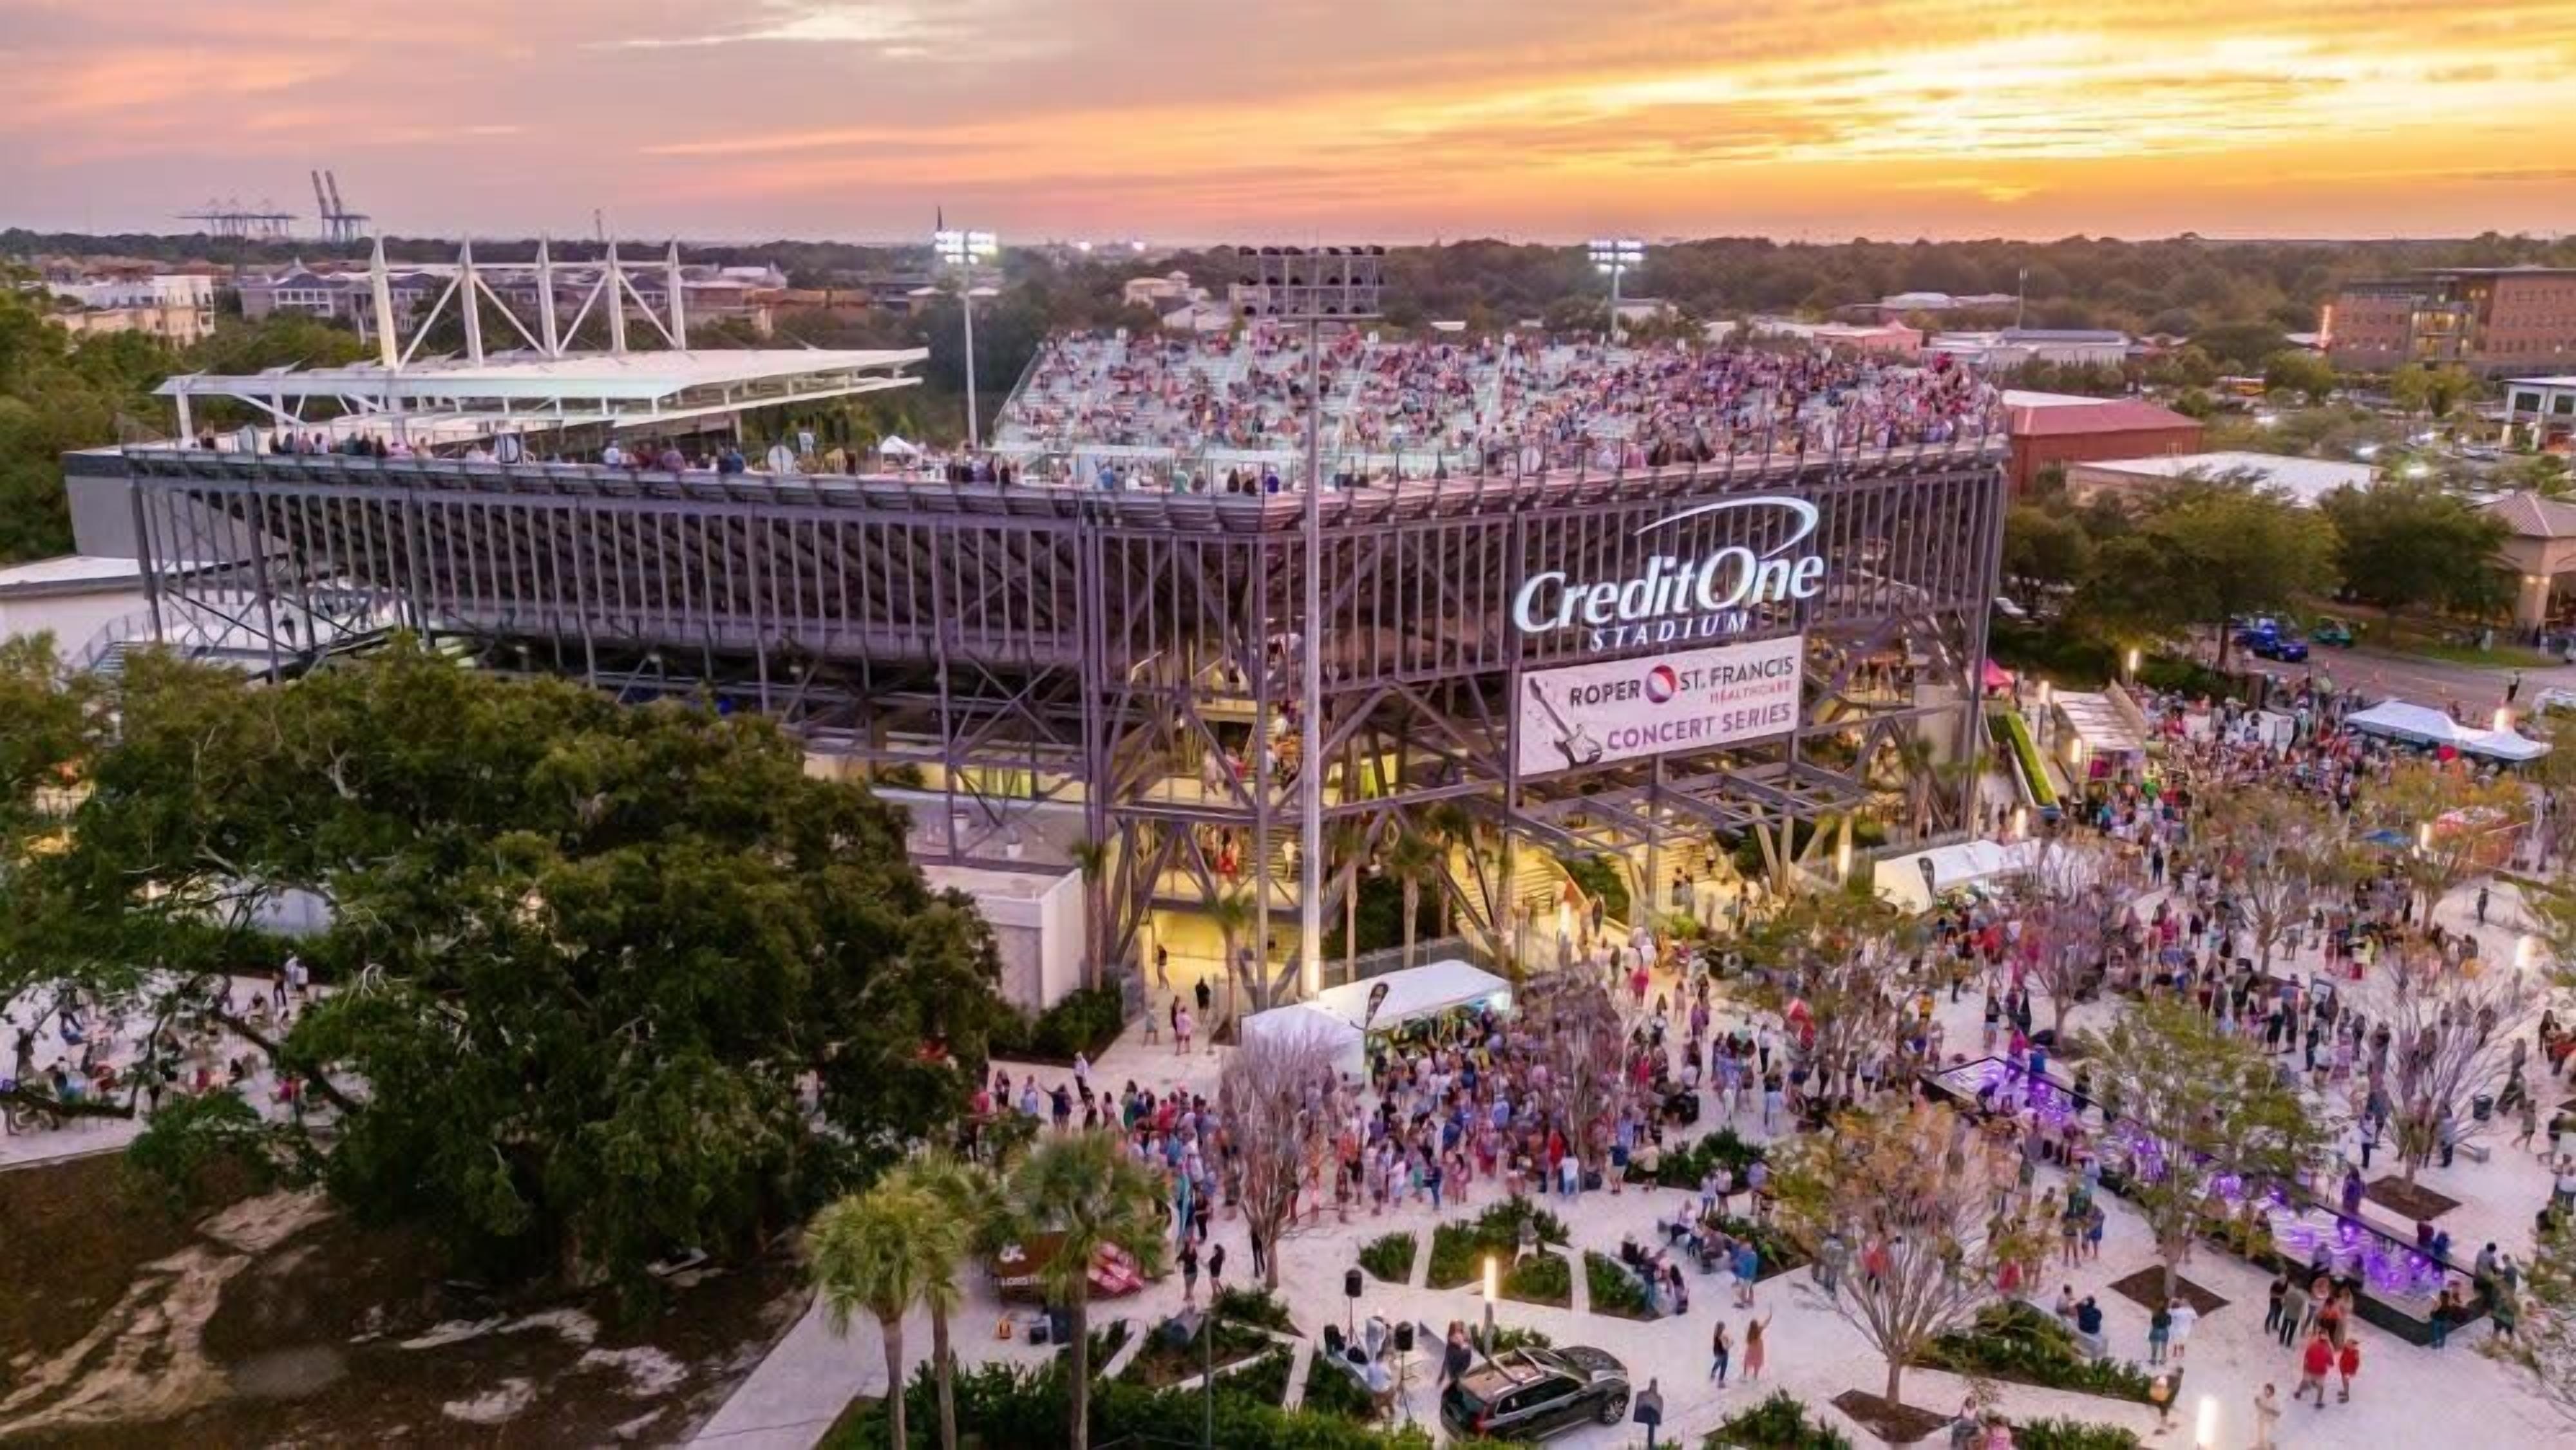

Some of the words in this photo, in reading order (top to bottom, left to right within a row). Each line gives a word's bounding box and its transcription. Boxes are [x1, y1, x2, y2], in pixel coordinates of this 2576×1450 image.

[1591, 610, 1749, 652] STADIUM
[1569, 679, 1642, 708] ROPER
[1678, 670, 1706, 691] ST.
[1710, 656, 1794, 688] FRANCIS
[1607, 716, 1716, 750] CONCERT
[1722, 703, 1791, 733] SERIES
